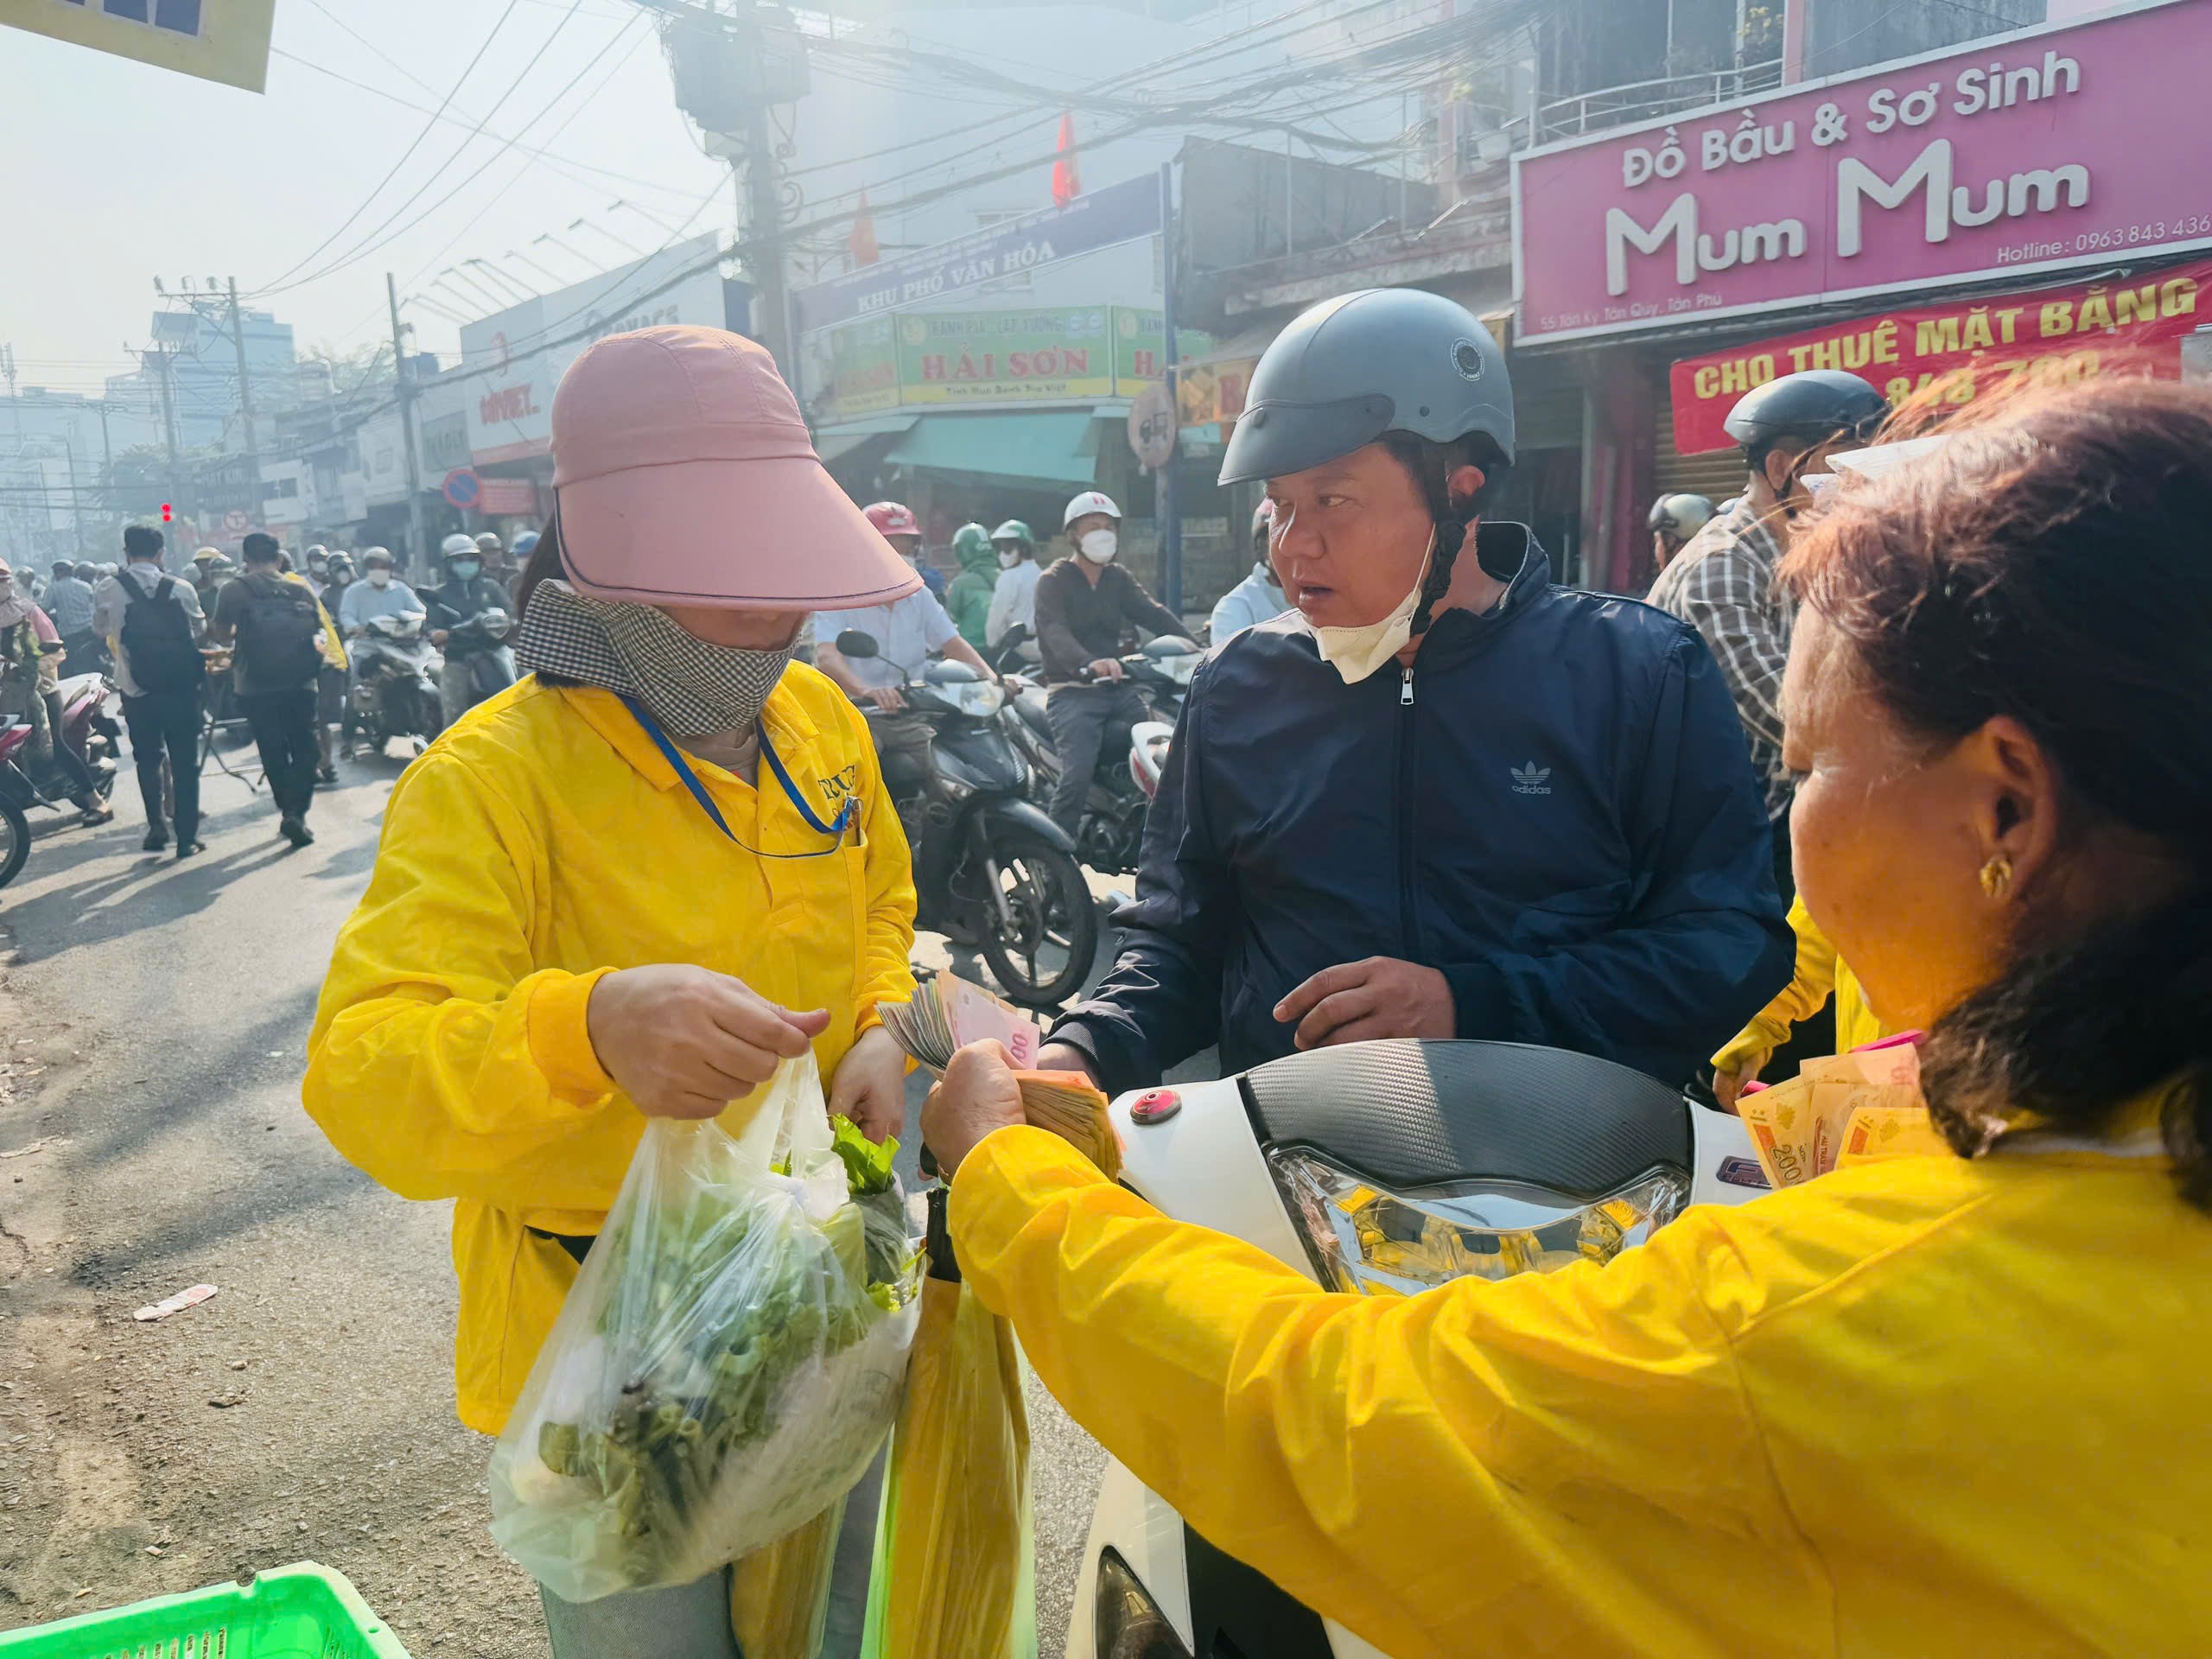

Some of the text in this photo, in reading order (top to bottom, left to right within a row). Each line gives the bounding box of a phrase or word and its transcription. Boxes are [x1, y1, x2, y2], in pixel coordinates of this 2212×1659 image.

[1623, 50, 2081, 188] Đồ Bầu & Sơ Sinh
[1605, 138, 2090, 296] Mum Mum
[2075, 229, 2124, 251] 0963
[2128, 222, 2166, 243] 843
[2172, 214, 2211, 237] 436
[857, 288, 897, 313] KHU
[1003, 241, 1056, 272] HÓA
[921, 341, 996, 381] HẢI
[1008, 344, 1090, 378] SƠN
[1694, 277, 2199, 399] CHO THUÊ MẶT BẰNG
[1511, 785, 1552, 795] adidas
